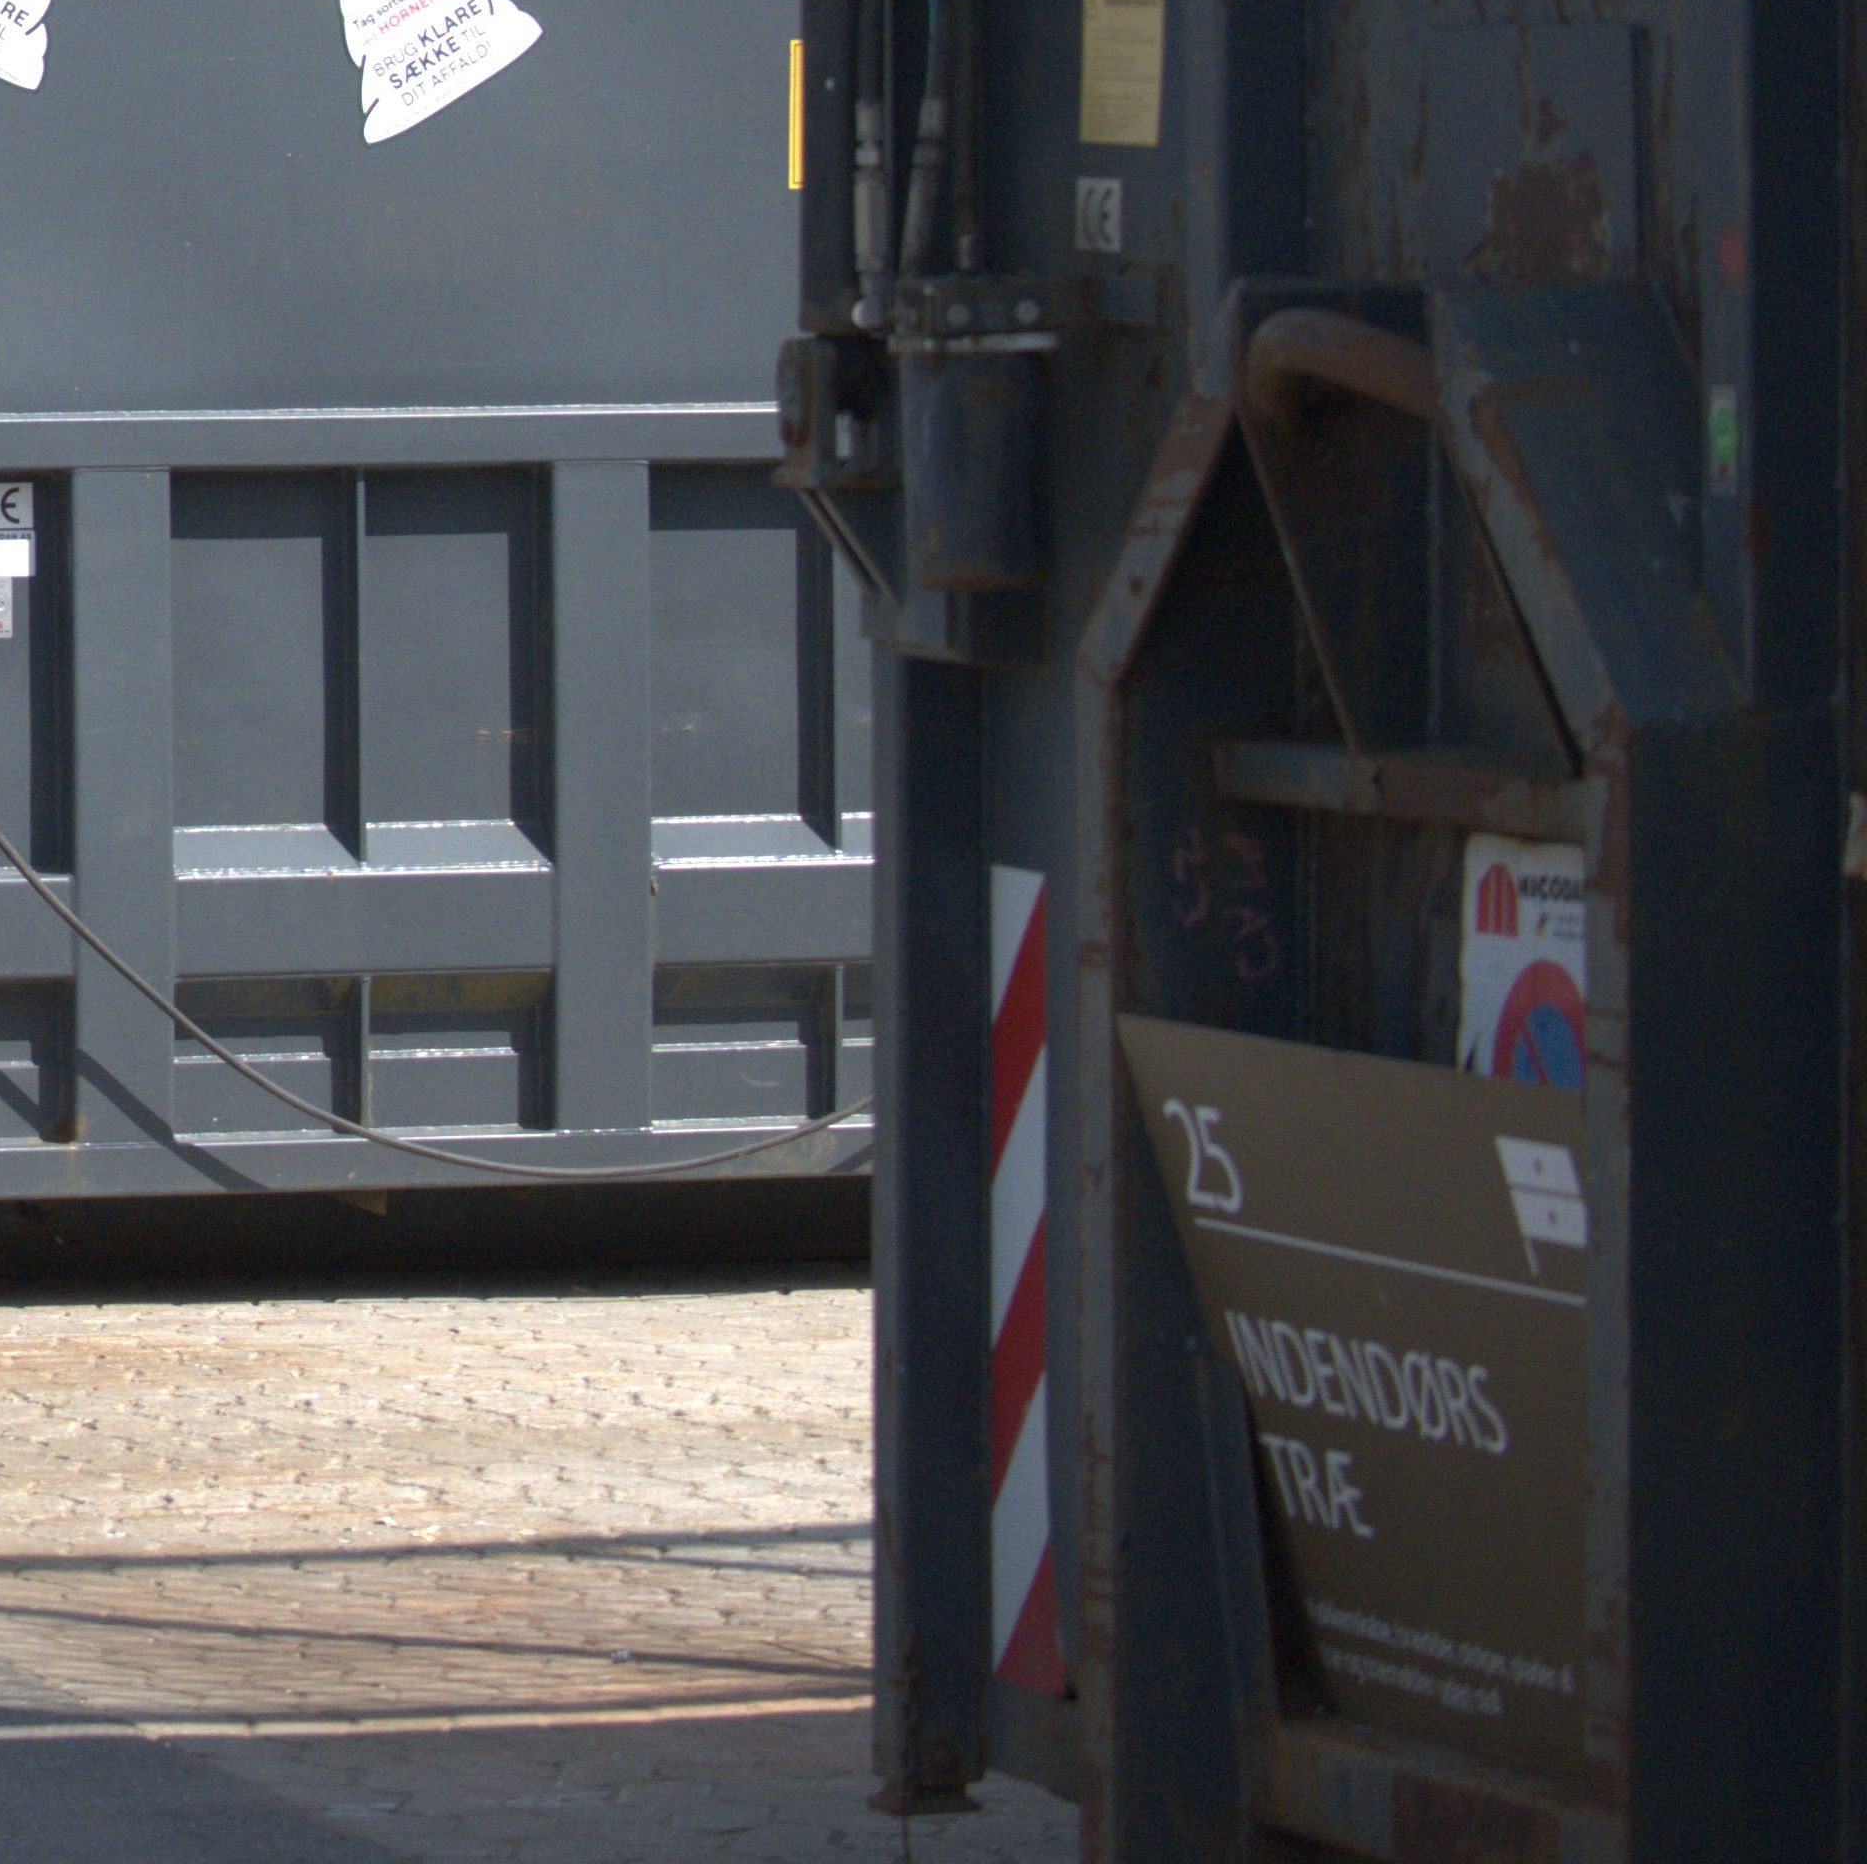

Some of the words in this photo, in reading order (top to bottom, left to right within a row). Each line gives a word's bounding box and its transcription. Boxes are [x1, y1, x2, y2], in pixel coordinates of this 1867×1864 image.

[351, 12, 375, 30] Tag
[372, 42, 419, 77] BRUG
[389, 36, 461, 90] SÆKKE
[464, 25, 486, 43] TIL
[401, 83, 428, 107] DIT
[1162, 1097, 1245, 1214] 25
[1223, 1308, 1509, 1455] INDENDØRS
[1260, 1432, 1376, 1538] TRÆ
